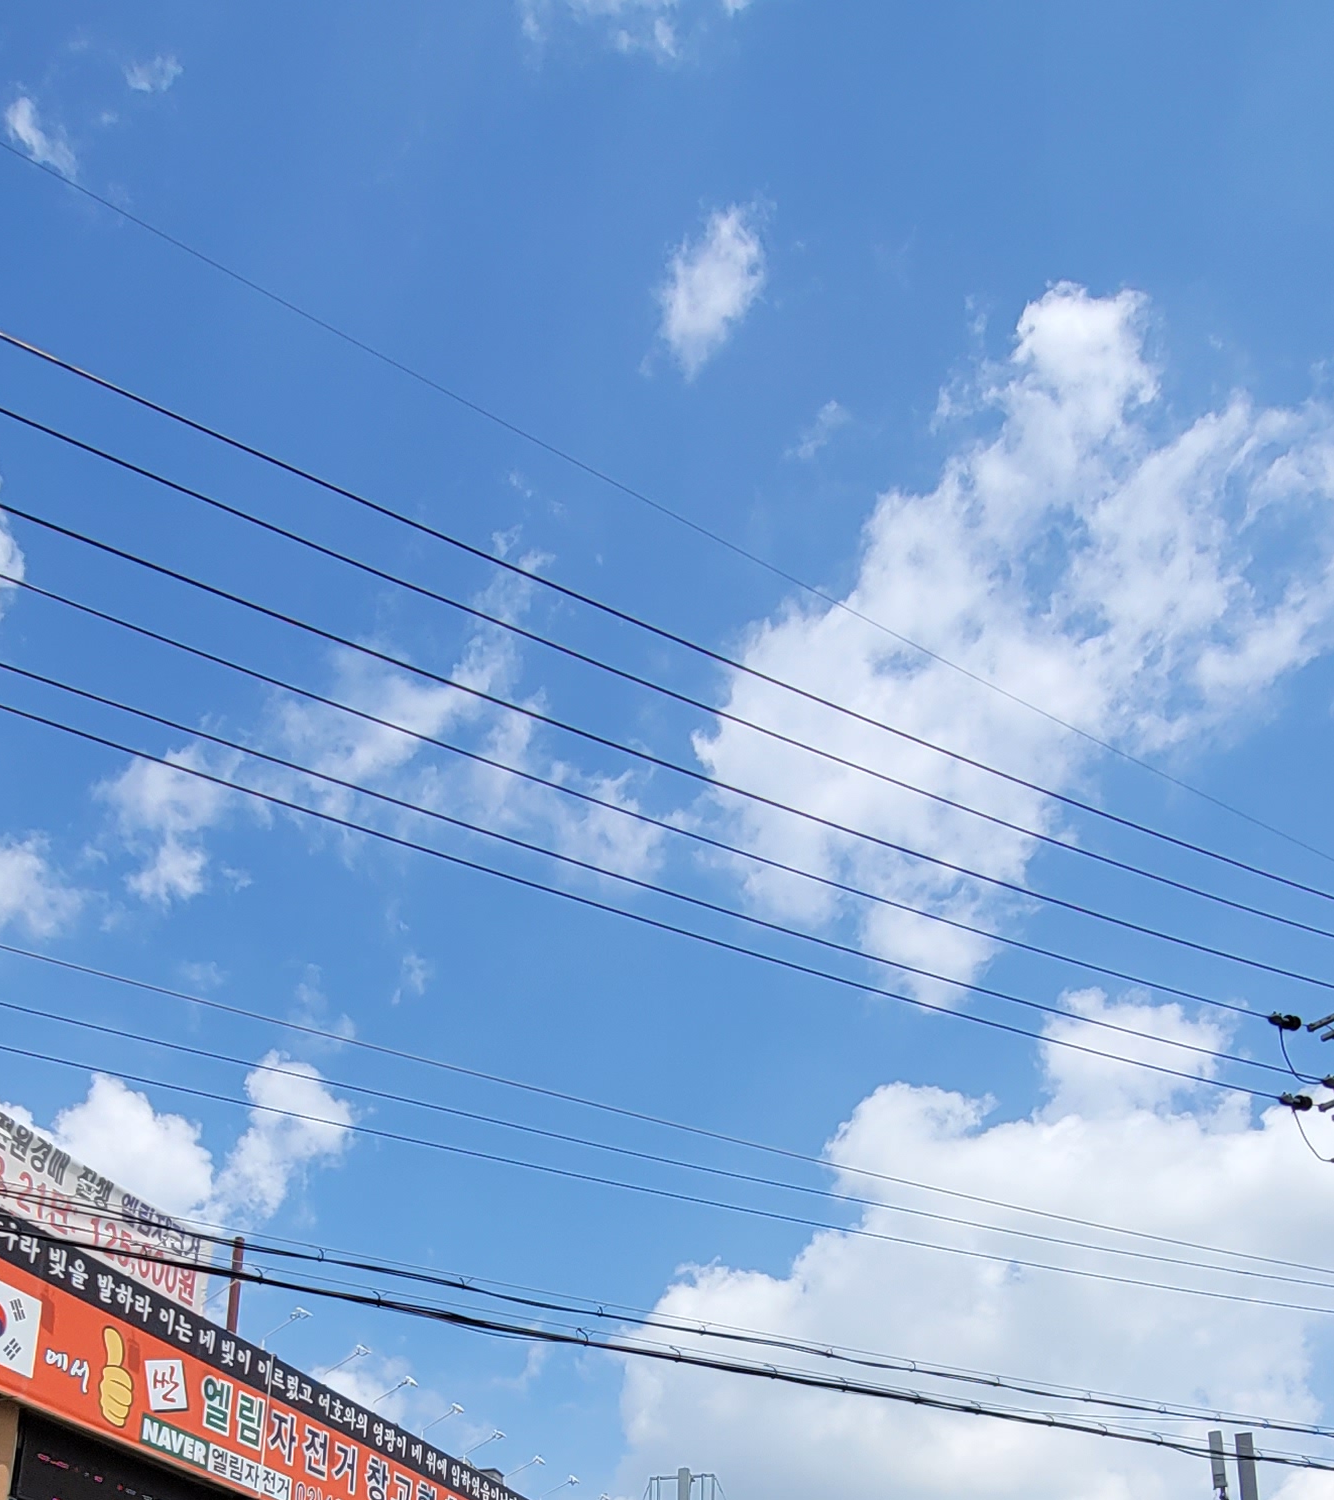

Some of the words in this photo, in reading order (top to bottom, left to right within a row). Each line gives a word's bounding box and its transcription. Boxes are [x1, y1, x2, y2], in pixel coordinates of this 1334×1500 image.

[44, 1347, 90, 1394] 에서
[201, 1375, 358, 1494] 엘림자전거
[49, 1247, 89, 1291] 빛을
[96, 1274, 152, 1322] 발하라
[159, 1308, 193, 1342] 이는
[199, 1329, 216, 1354] 네
[221, 1339, 251, 1375] 빛이
[319, 1393, 368, 1438] 여호와의
[373, 1423, 407, 1458] 영광이
[144, 1417, 207, 1464] NAVER
[211, 1448, 291, 1499] 엘림자전거
